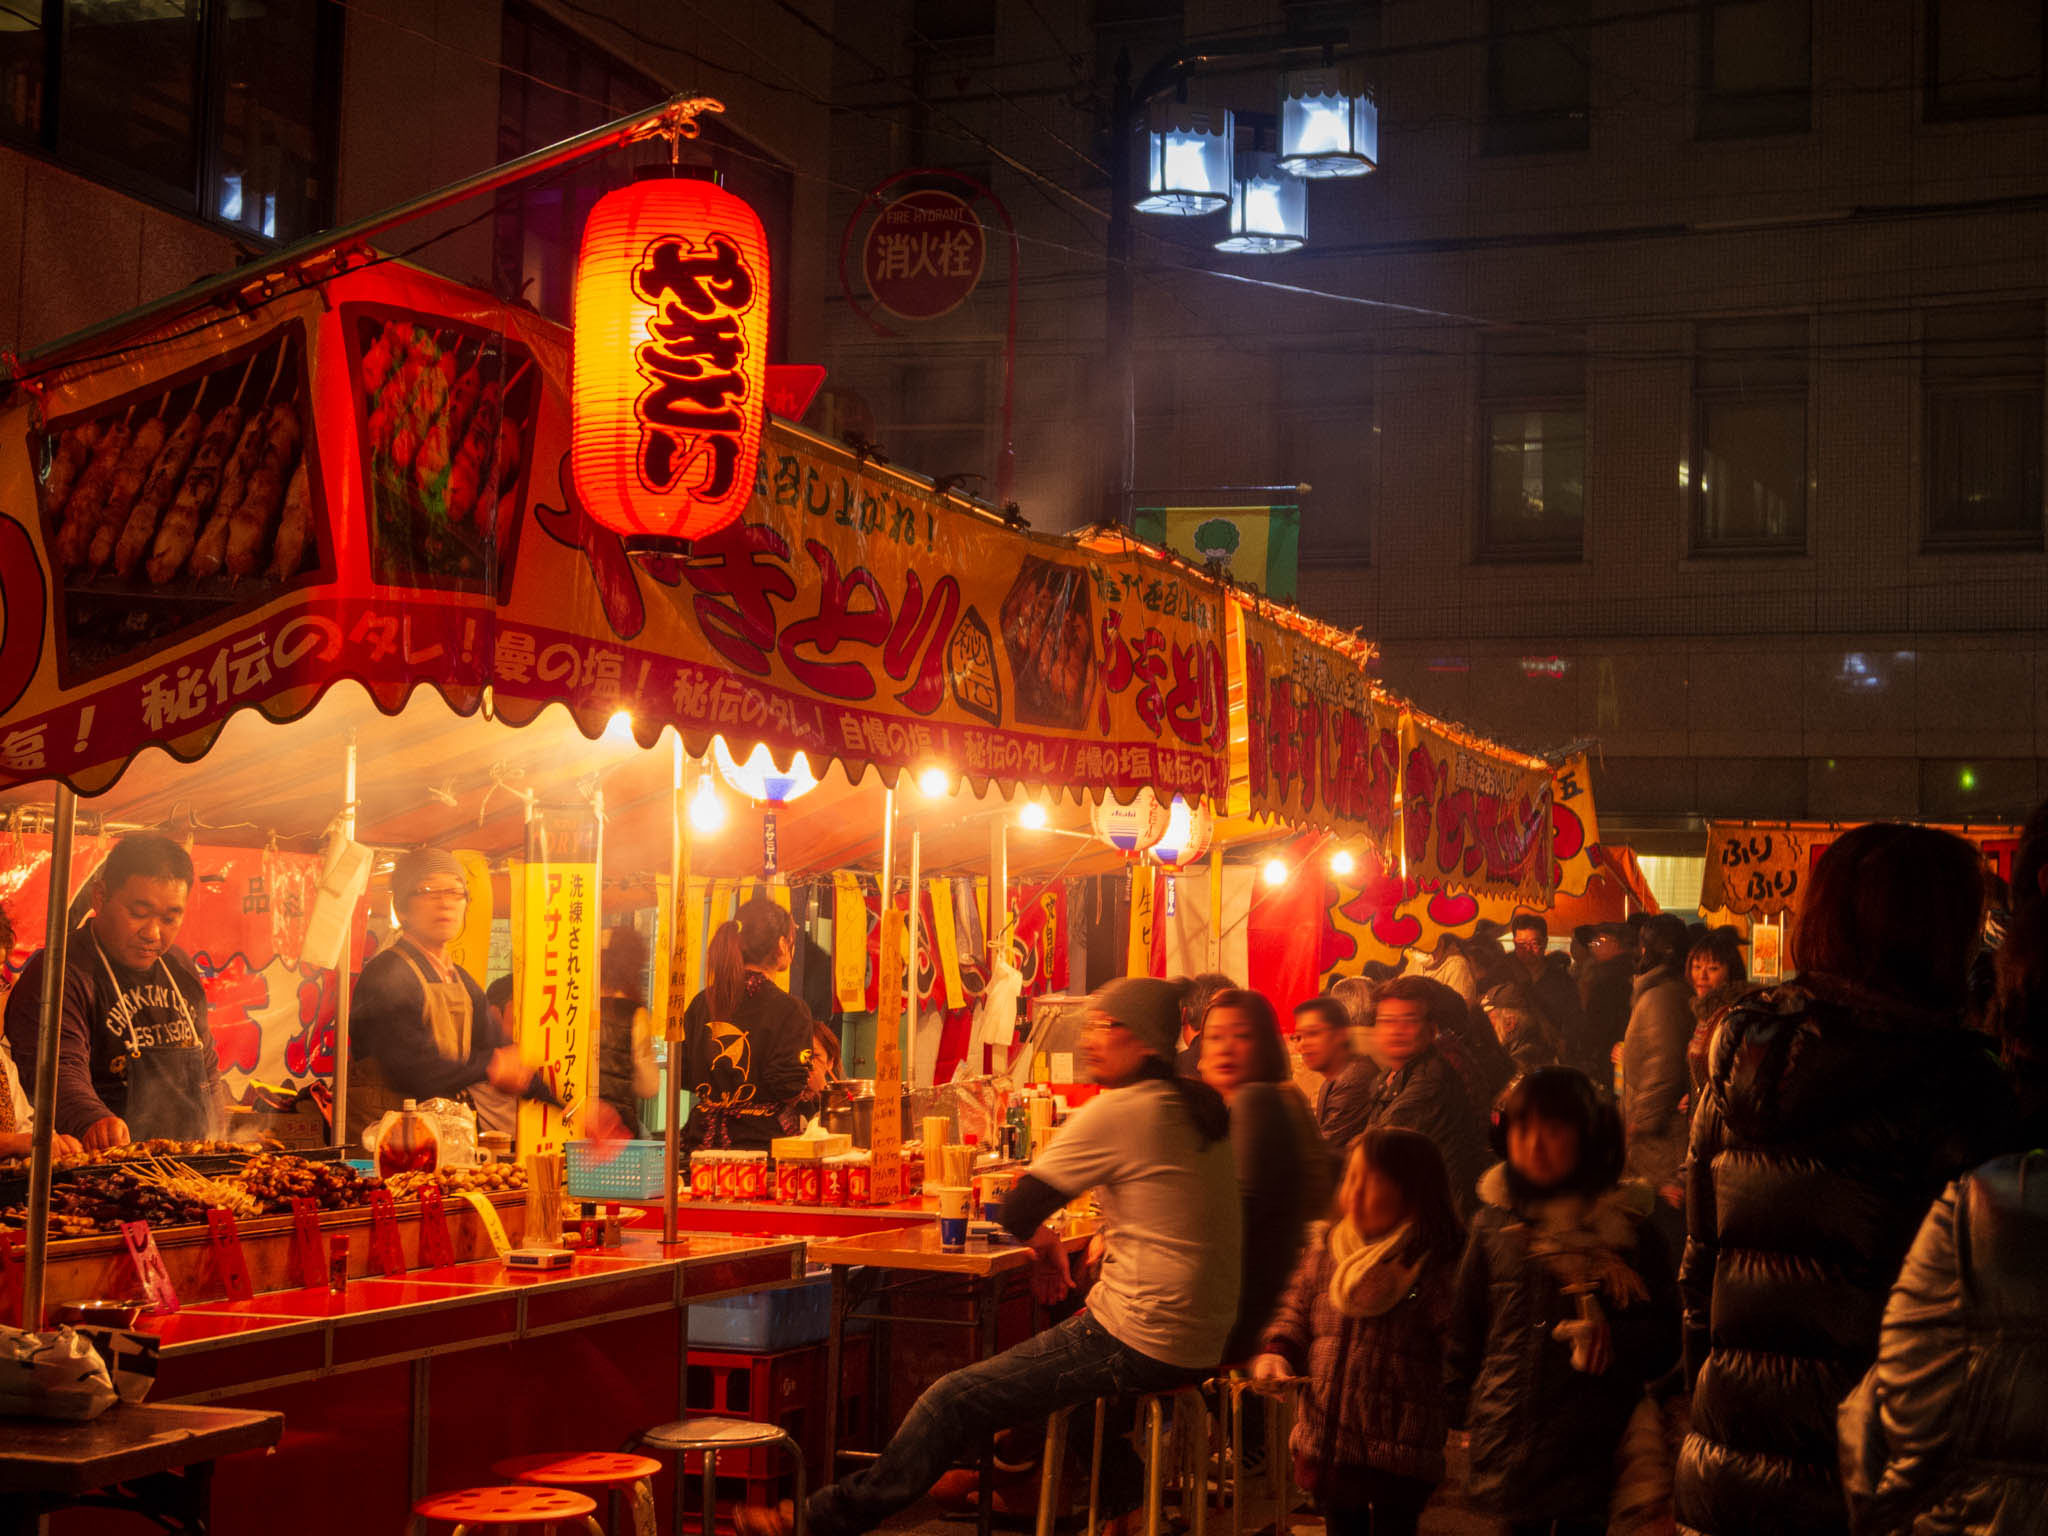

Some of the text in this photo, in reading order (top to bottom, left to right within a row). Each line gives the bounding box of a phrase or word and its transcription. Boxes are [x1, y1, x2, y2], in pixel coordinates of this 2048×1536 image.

[885, 207, 965, 224] FIRE HYDRANT
[876, 228, 975, 281] 消火栓
